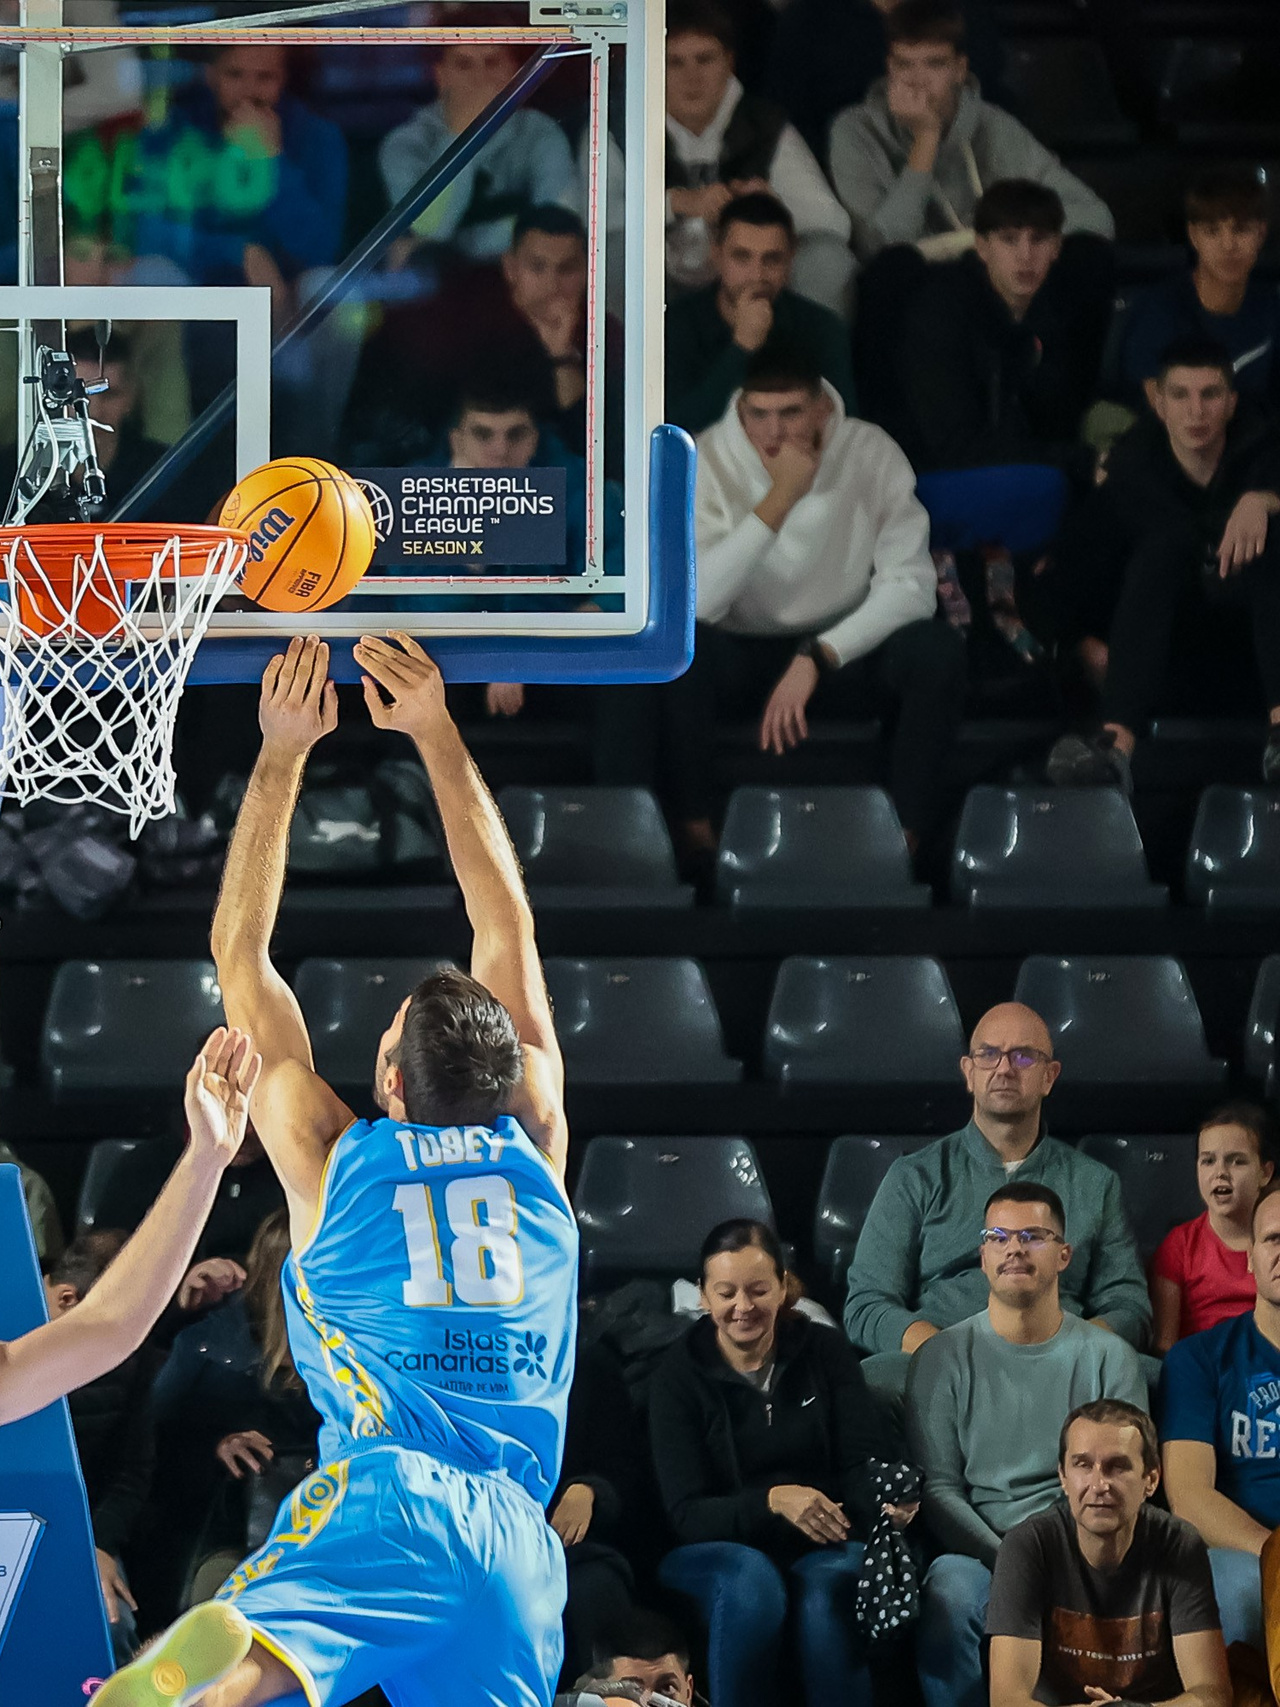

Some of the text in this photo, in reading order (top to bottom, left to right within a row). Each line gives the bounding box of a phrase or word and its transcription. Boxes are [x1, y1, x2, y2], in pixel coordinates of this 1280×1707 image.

[401, 477, 538, 494] BASKETBALL
[401, 496, 554, 515] CHAMPIONS
[401, 518, 484, 534] LEAGUE
[234, 507, 296, 585] Wil
[402, 541, 484, 555] SEASON X
[295, 571, 322, 598] FIBA
[395, 1126, 504, 1171] TOBEY
[391, 1174, 524, 1306] 18
[445, 1328, 509, 1351] Islas
[384, 1351, 510, 1375] Canarias
[1249, 1380, 1280, 1410] PRO
[1231, 1409, 1280, 1459] RE
